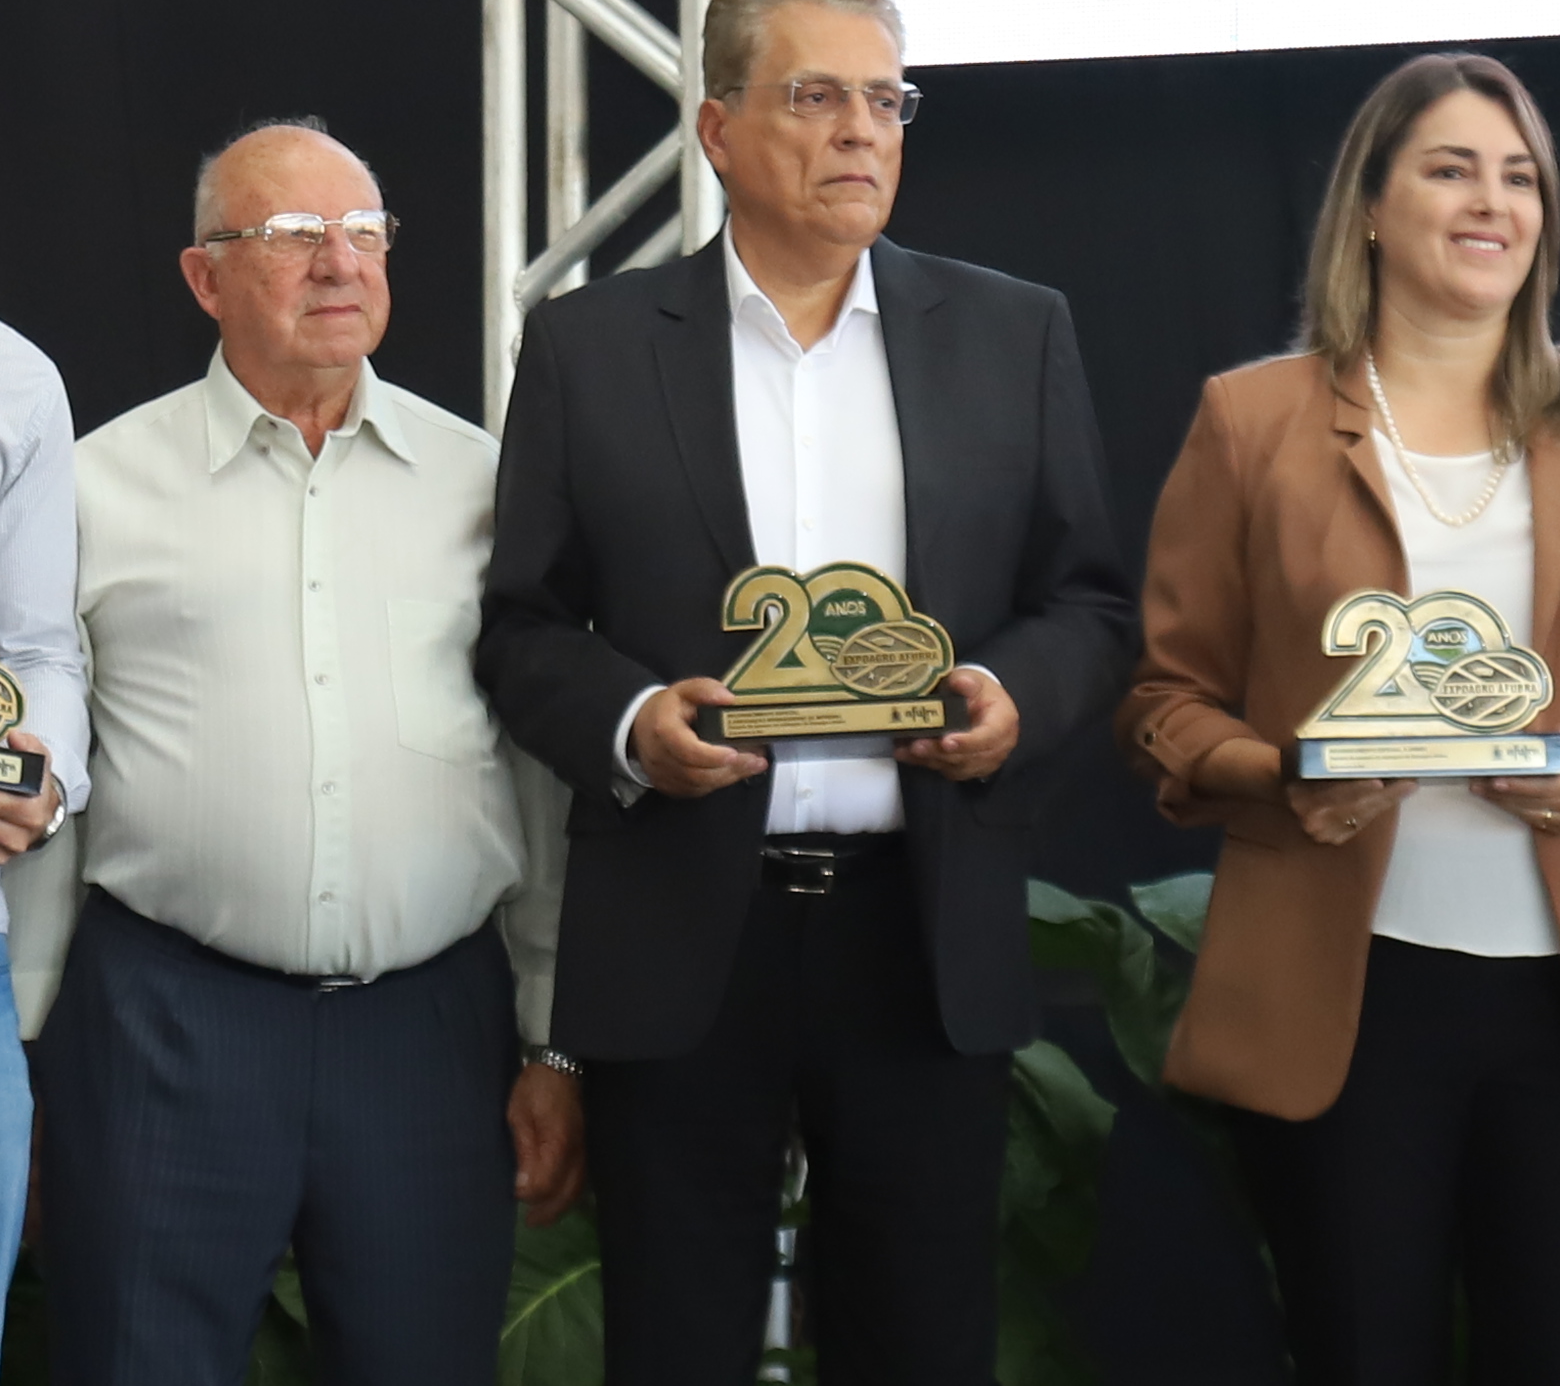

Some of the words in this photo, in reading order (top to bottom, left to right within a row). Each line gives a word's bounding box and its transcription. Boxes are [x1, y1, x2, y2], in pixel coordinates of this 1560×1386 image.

[731, 568, 906, 690] 20
[824, 600, 867, 617] ANOS
[1427, 629, 1468, 644] ANOS
[1329, 597, 1507, 717] 20
